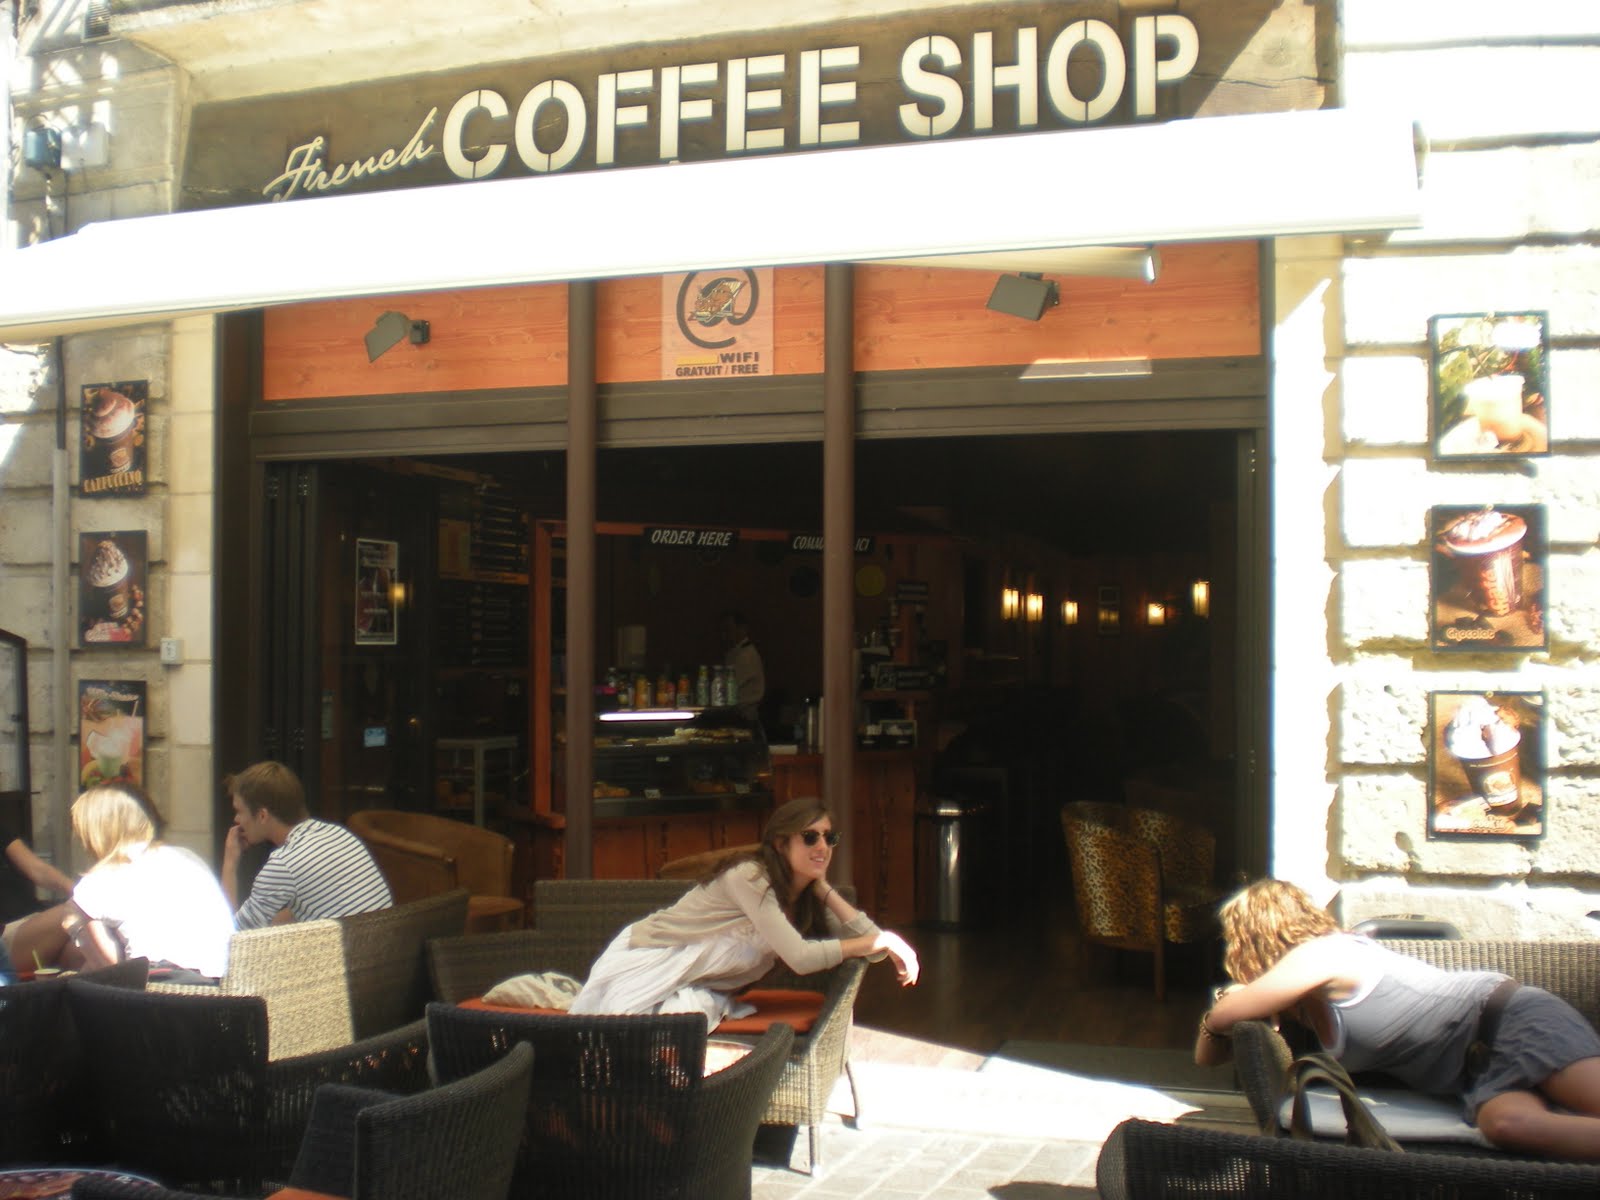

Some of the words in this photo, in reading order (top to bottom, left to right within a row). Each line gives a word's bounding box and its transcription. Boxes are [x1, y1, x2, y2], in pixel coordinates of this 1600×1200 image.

[263, 107, 437, 201] French
[442, 46, 860, 179] COFFEE
[899, 15, 1200, 138] SHOP
[720, 351, 759, 363] WIFI
[675, 366, 722, 377] GRATUIT
[731, 364, 759, 374] FREE
[651, 529, 695, 545] ORDER
[697, 531, 733, 547] HERE
[855, 538, 870, 551] ICI
[1446, 627, 1496, 642] Chocolat
